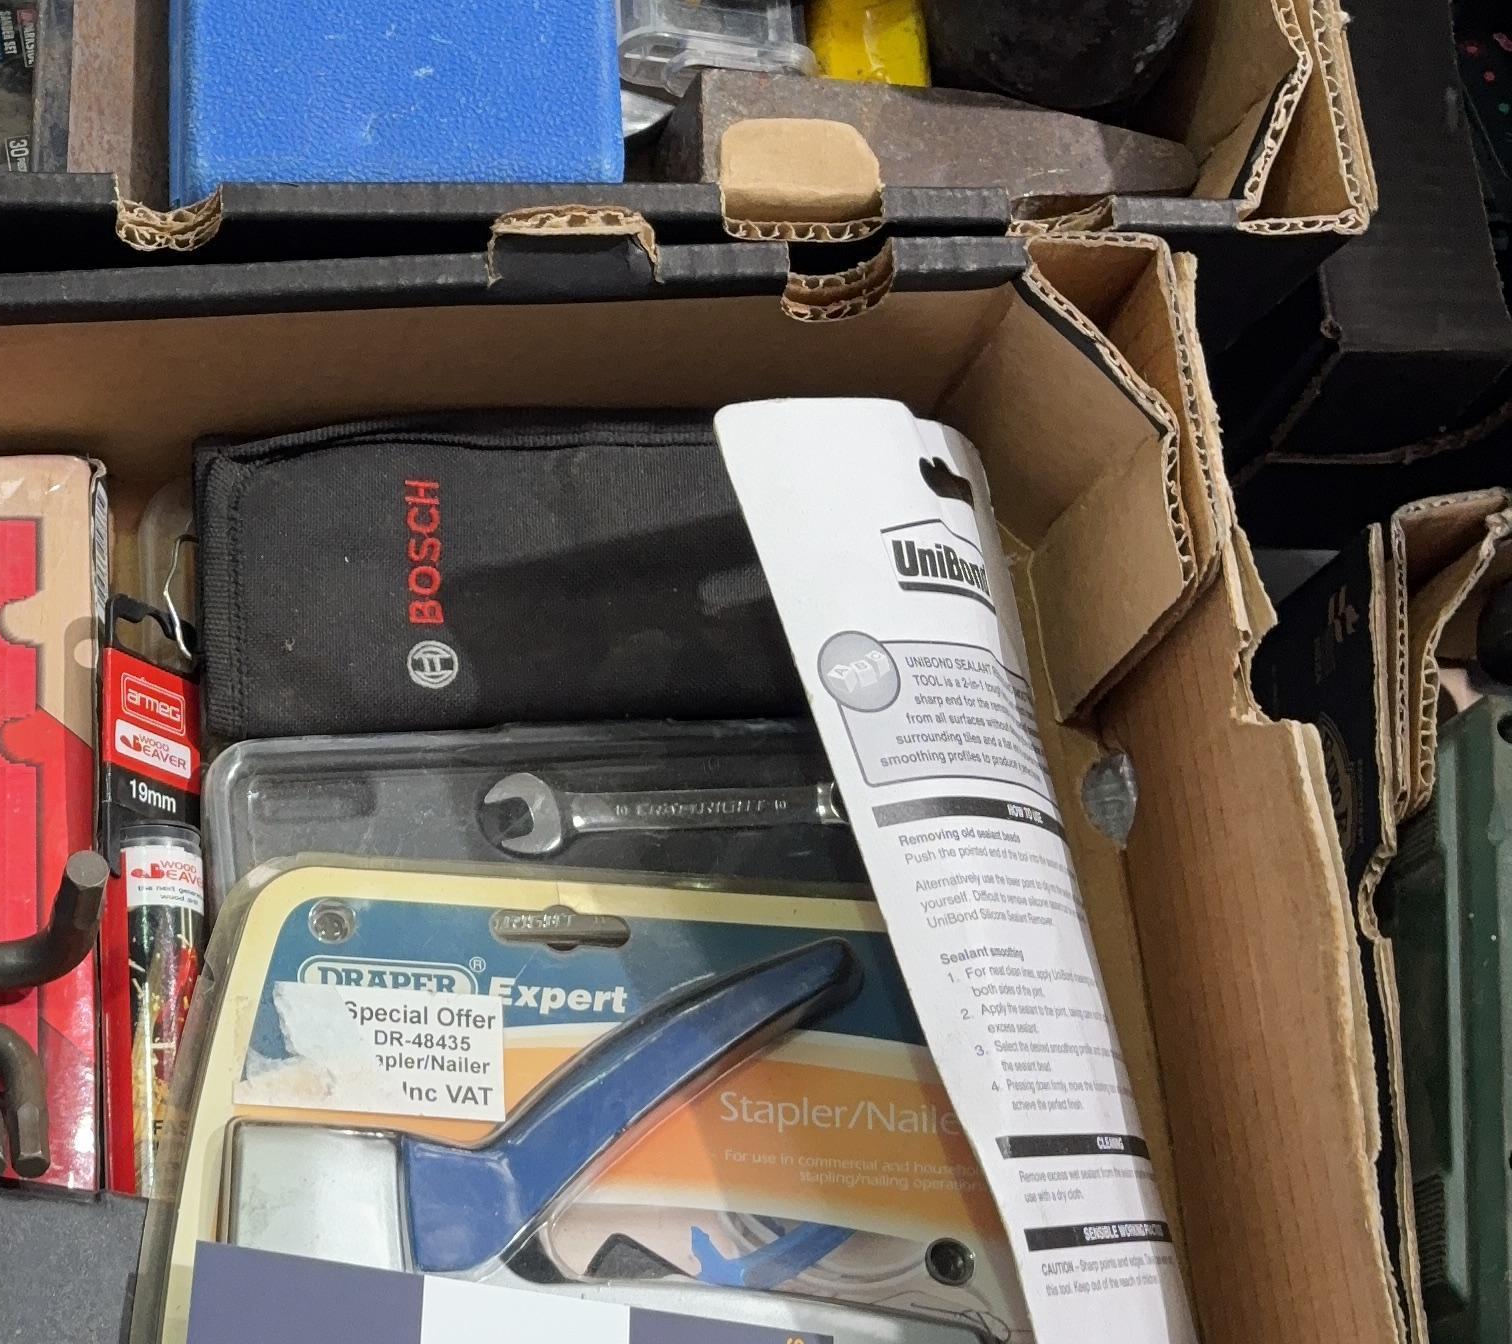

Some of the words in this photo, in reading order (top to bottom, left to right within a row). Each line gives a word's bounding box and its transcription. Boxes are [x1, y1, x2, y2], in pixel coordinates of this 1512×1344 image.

[3, 41, 17, 54] SET
[8, 139, 29, 157] 30
[404, 478, 445, 626] BOSCH
[903, 655, 954, 671] UNIBOND
[911, 673, 943, 688] TOOL
[943, 677, 952, 687] is
[913, 692, 943, 707] sharp
[945, 694, 962, 705] end
[963, 696, 975, 706] for
[905, 711, 933, 725] from
[935, 712, 946, 723] all
[948, 713, 985, 726] surfaces
[140, 733, 169, 751] WOOD
[896, 731, 962, 747] surrounding
[963, 731, 982, 743] tiles
[881, 750, 947, 769] smoothing
[949, 749, 982, 765] profiles
[129, 778, 176, 813] 19mm
[899, 828, 960, 847] Removing
[960, 827, 976, 839] old
[904, 851, 937, 865] Push
[938, 847, 956, 860] the
[958, 846, 989, 861] pointed
[160, 860, 196, 873] WOOD
[915, 871, 981, 892] Alternatively
[919, 891, 968, 912] yourself.
[927, 909, 979, 930] UniBond
[940, 946, 990, 966] Sealant
[964, 964, 987, 980] For
[317, 961, 458, 996] DRAPER
[493, 977, 629, 1017] Expert
[970, 983, 998, 999] both
[437, 1007, 495, 1029] Offer
[959, 1007, 974, 1022] 2.
[979, 1000, 1006, 1018] Apply
[374, 1029, 471, 1051] DR-48435
[973, 1043, 989, 1057] 3.
[992, 1038, 1018, 1055] Select
[445, 1084, 493, 1105] VAT
[1041, 1260, 1074, 1277] CAUTION
